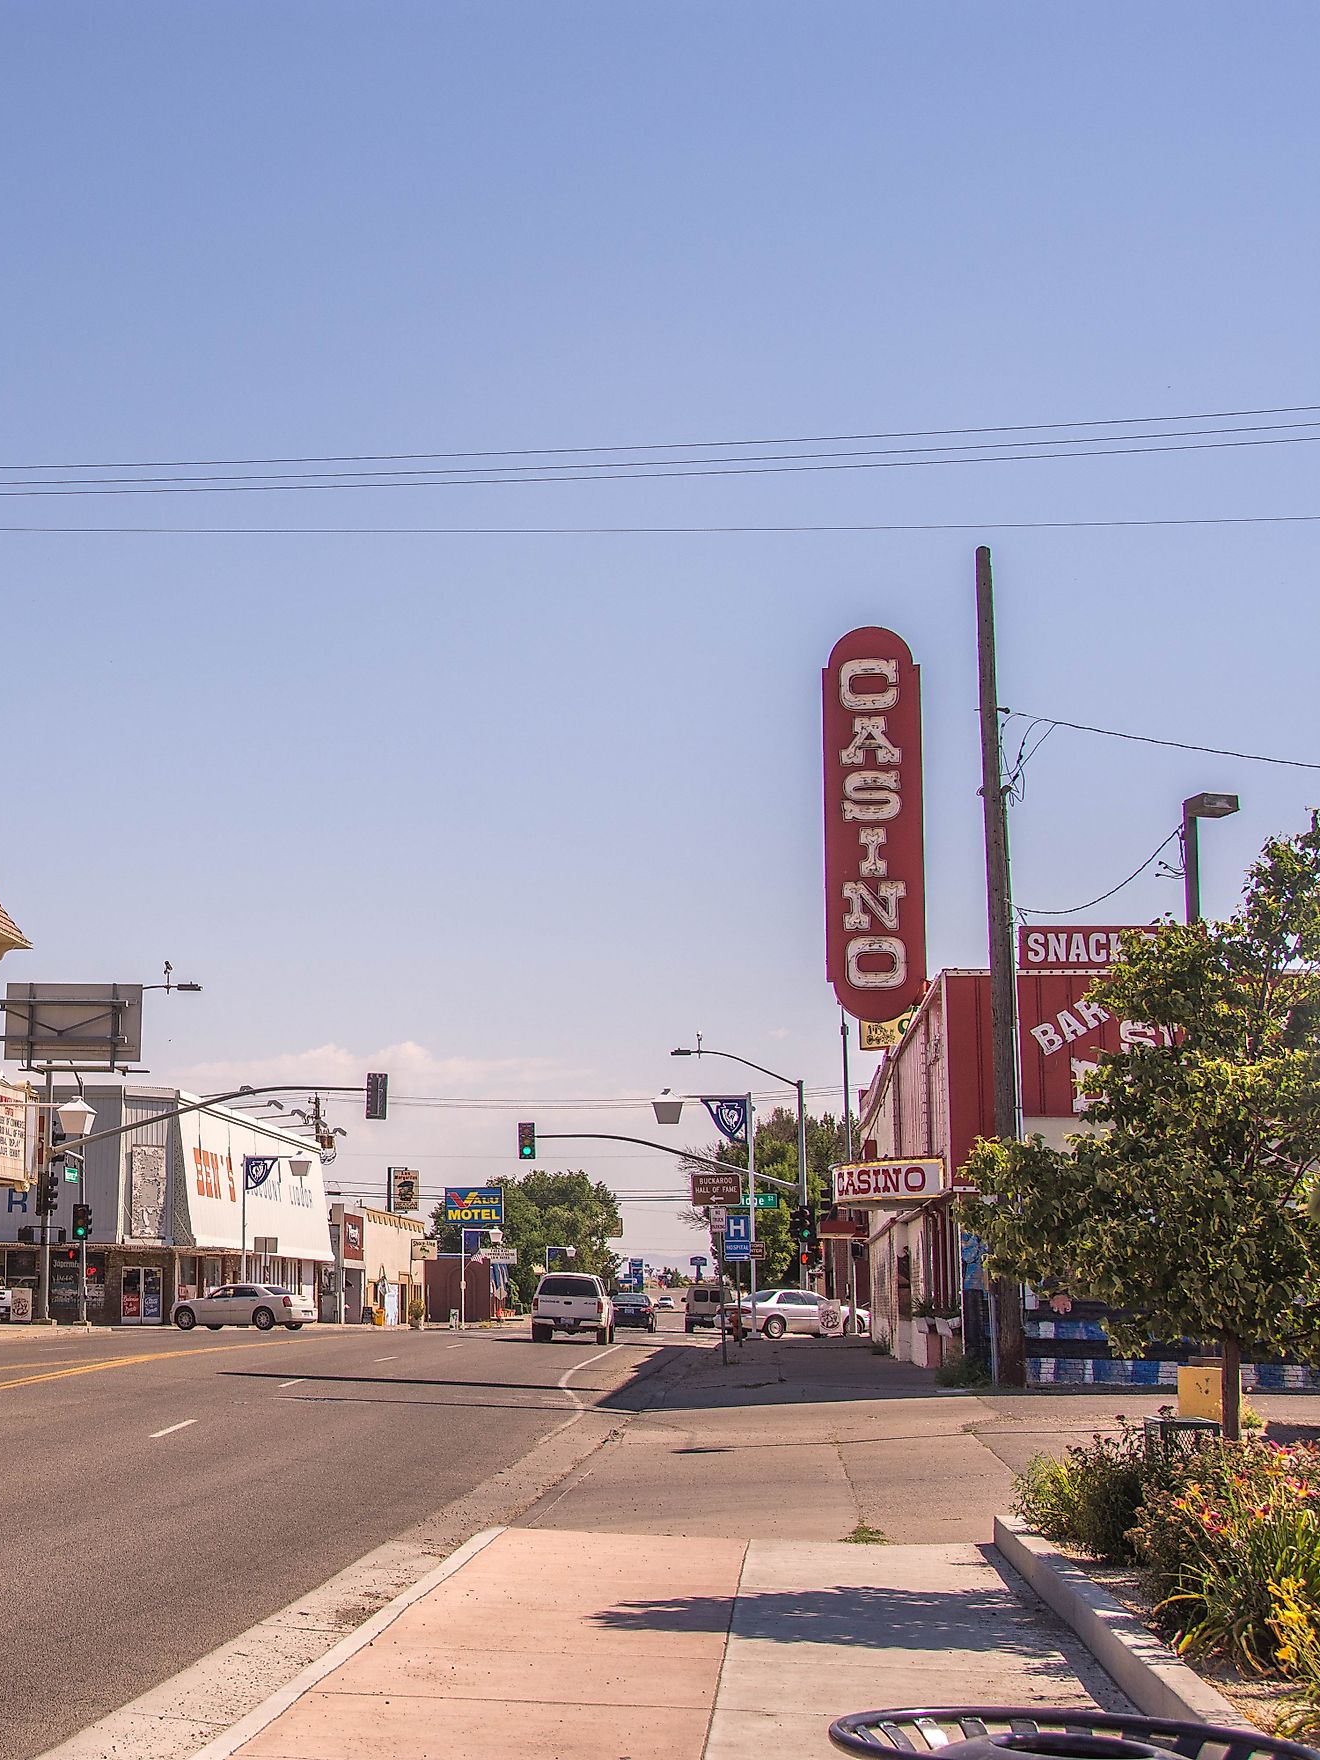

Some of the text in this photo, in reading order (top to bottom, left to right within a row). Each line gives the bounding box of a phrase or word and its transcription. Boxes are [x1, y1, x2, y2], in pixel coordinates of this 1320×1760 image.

[838, 657, 907, 991] CASINO
[1027, 932, 1129, 963] SNACK
[1030, 999, 1111, 1057] BAR
[246, 1179, 282, 1203] SCOUNT
[695, 1186, 710, 1194] HALL
[722, 1185, 738, 1193] FAME
[699, 1177, 733, 1185] BUCKAROO
[837, 1166, 926, 1197] CASINO
[447, 1191, 500, 1209] VALU
[447, 1209, 501, 1221] MOTEL
[729, 1218, 745, 1238] H
